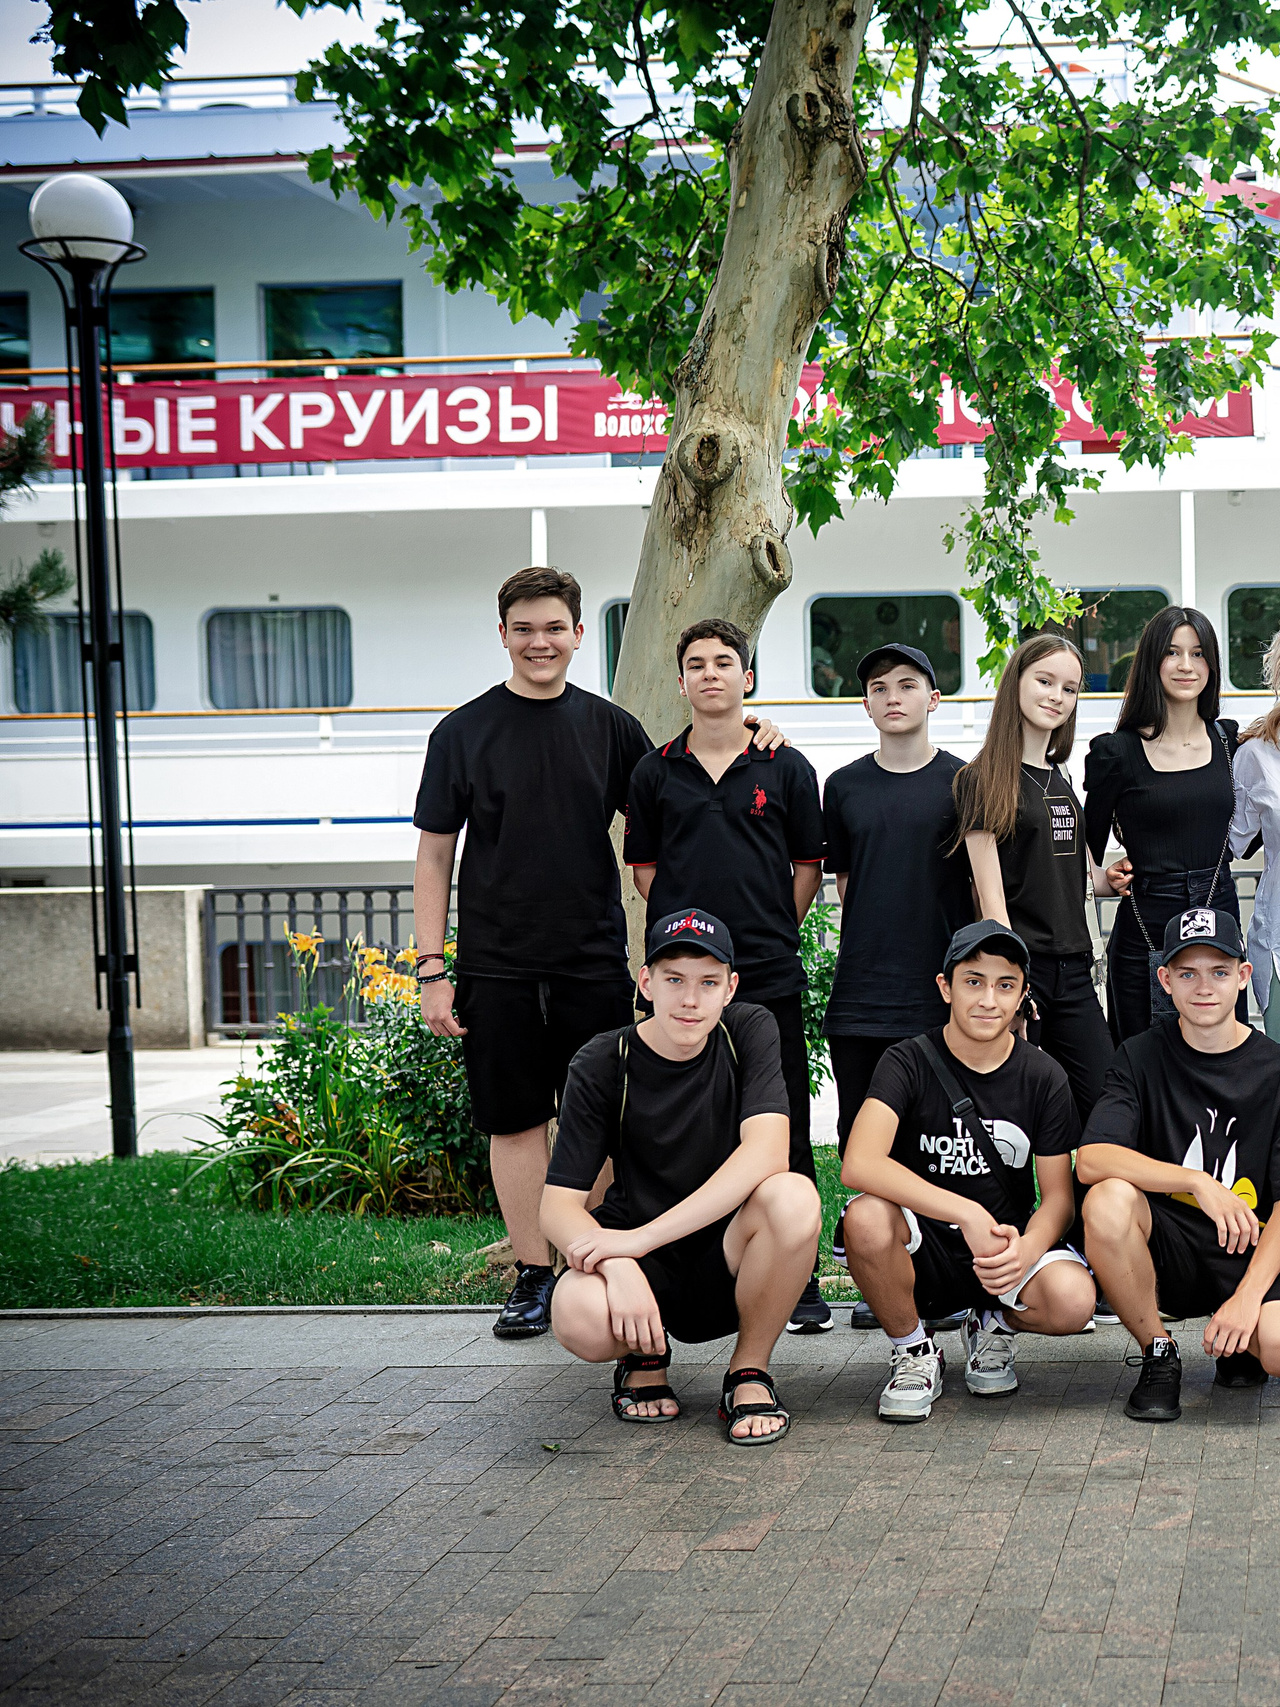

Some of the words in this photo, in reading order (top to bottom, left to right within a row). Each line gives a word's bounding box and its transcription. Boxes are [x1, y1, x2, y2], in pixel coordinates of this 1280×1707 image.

[239, 384, 558, 452] КРУИЗЫ
[594, 411, 667, 437] Водохо
[1051, 805, 1071, 816] TRIBE
[1052, 817, 1075, 828] CALLED
[1053, 829, 1073, 841] CRITIC
[920, 1134, 983, 1157] NORT
[940, 1155, 991, 1176] FACE
